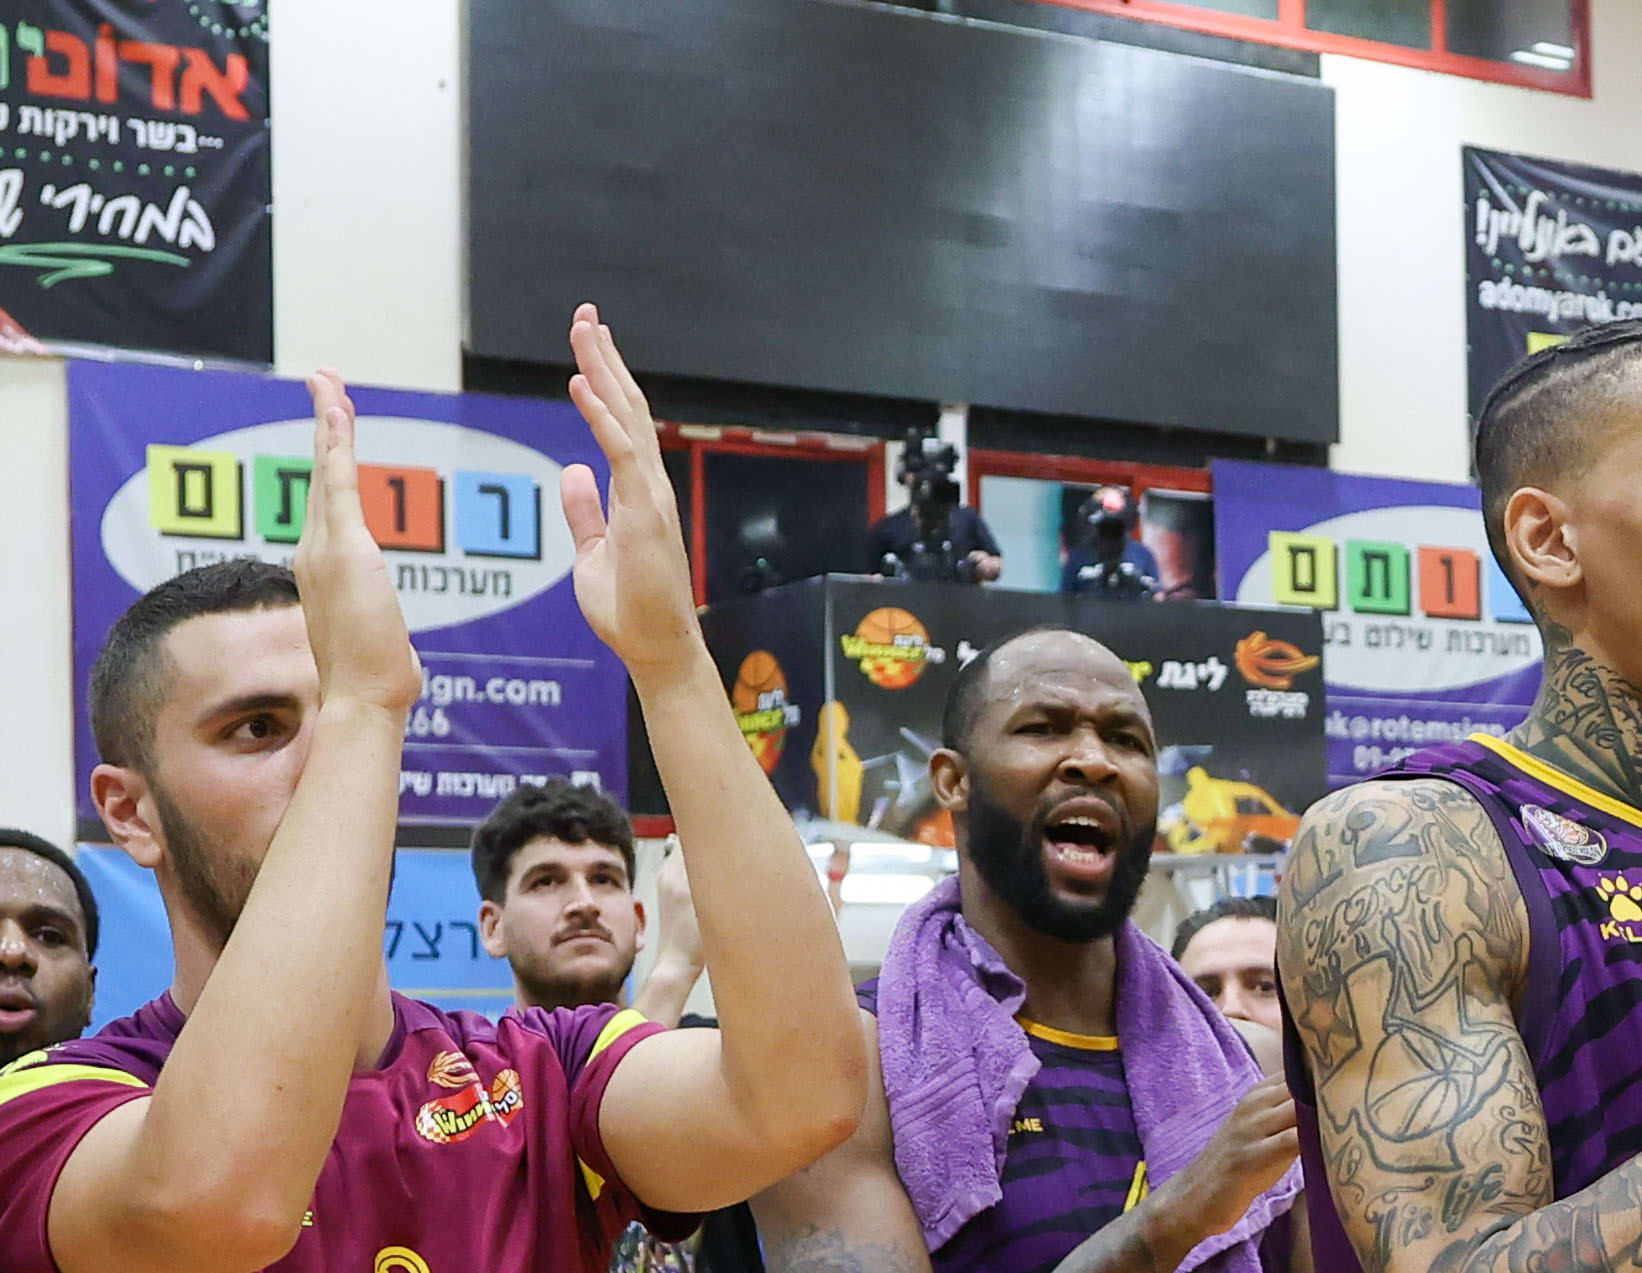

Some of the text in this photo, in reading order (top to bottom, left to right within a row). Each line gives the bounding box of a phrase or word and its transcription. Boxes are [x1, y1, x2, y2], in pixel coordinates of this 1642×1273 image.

[397, 564, 512, 598] מערכות
[1288, 544, 1455, 604] ותם
[405, 705, 450, 738] 66
[385, 919, 480, 960] רצל
